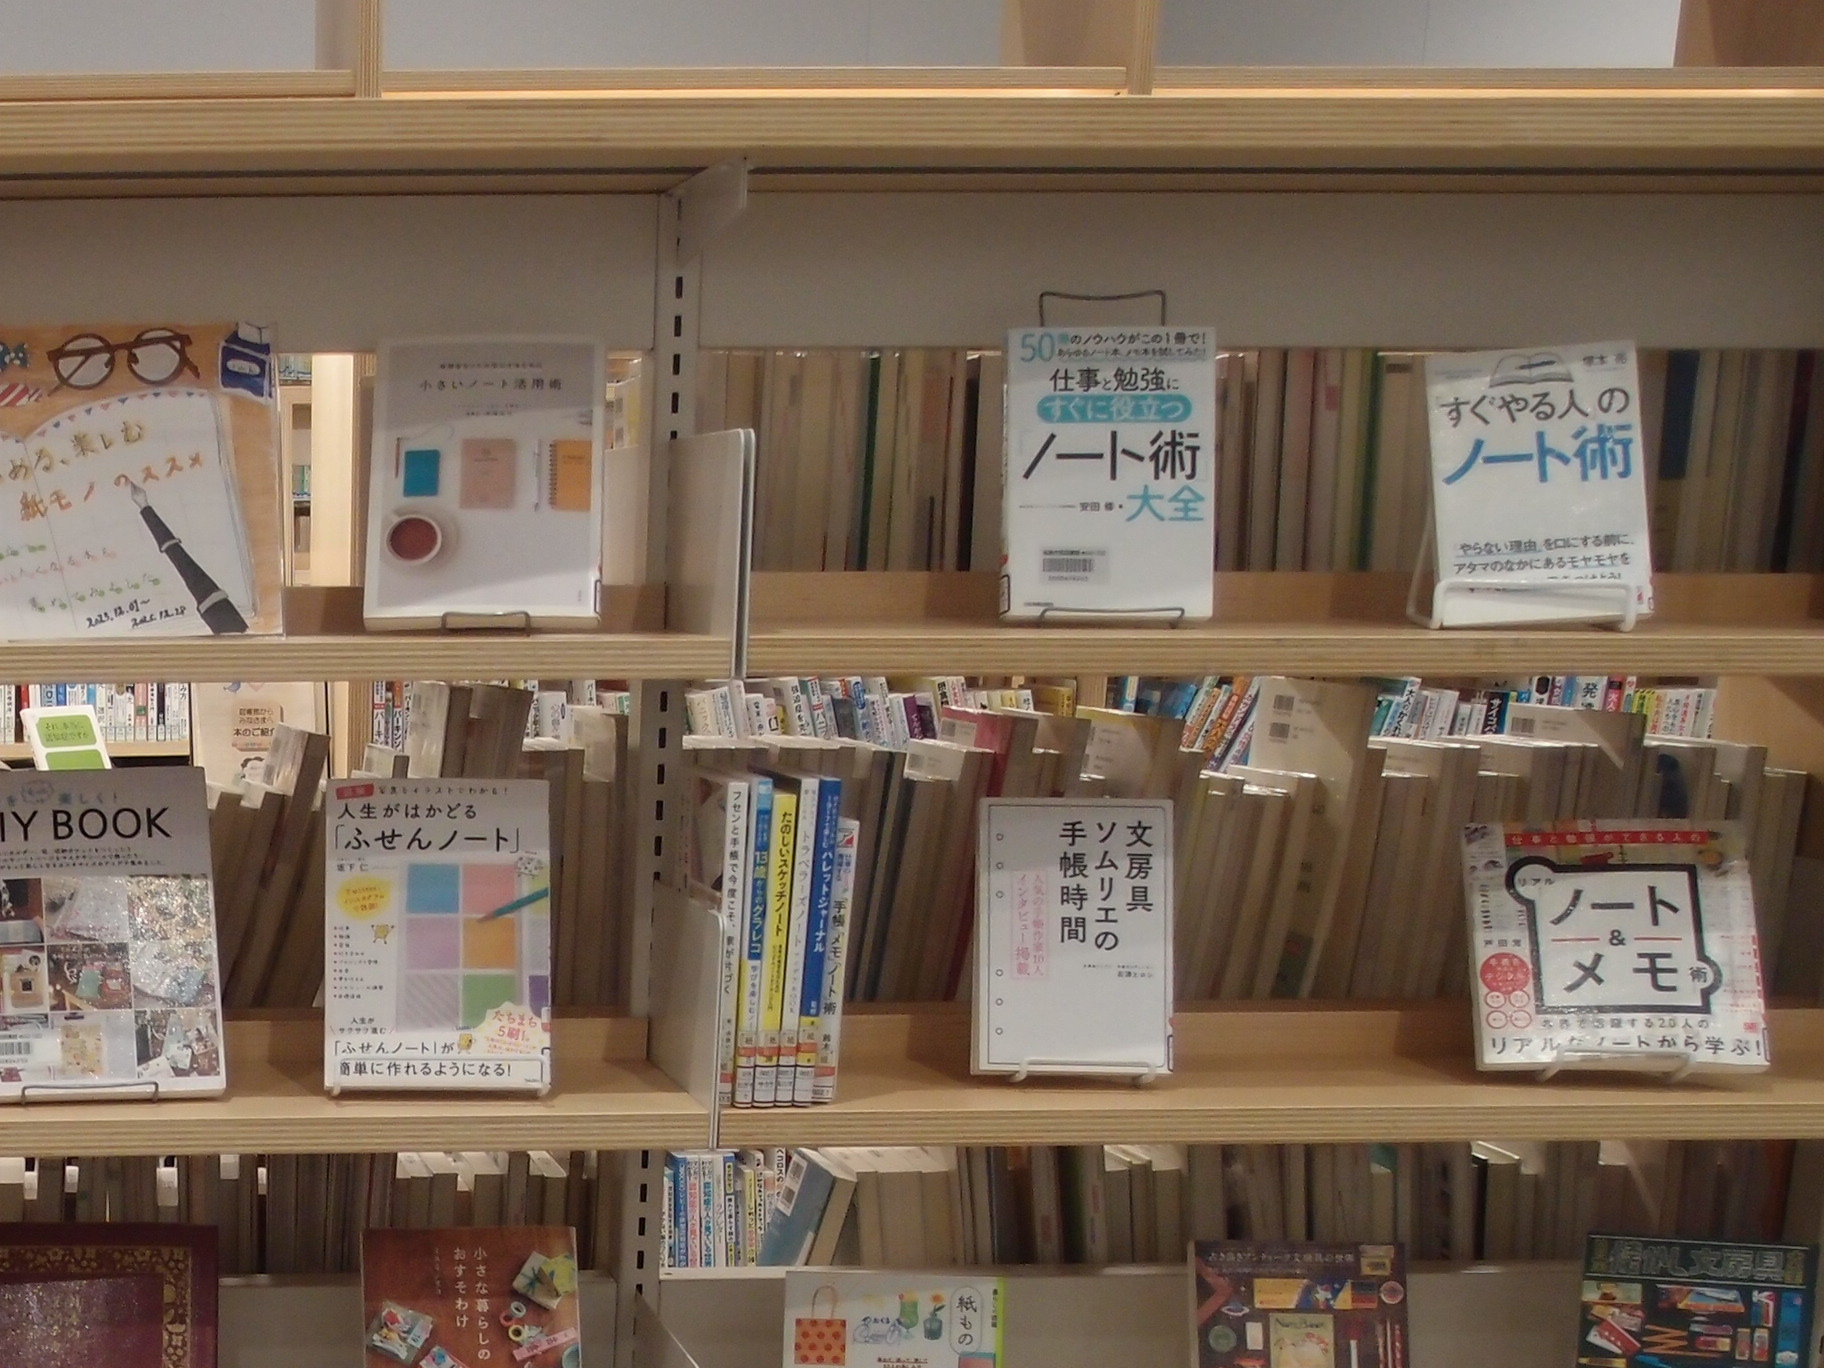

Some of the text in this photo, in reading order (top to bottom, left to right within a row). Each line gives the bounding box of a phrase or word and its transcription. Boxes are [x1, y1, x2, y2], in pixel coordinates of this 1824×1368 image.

[1049, 367, 1180, 392] 仕事と勉強に
[1044, 395, 1185, 421] すぐに役立つ
[1440, 387, 1631, 428] すぐやる人の
[1022, 429, 1201, 481] ノート術
[1441, 423, 1633, 486] ノート術
[1125, 484, 1206, 522] 大全
[1453, 552, 1631, 575] アタマのなかにあるモヤモヤを
[51, 807, 172, 841] BOOK
[337, 803, 478, 820] 人生がはかどる
[334, 823, 520, 854] 「ふせんノート」
[775, 811, 794, 937] たのしいスケッチノート
[1059, 820, 1089, 945] 手帳時間
[1124, 820, 1154, 913] 文房具
[1517, 876, 1556, 887] リアル
[1094, 820, 1120, 952] ソムリエの
[1549, 885, 1681, 926] ノート
[1608, 929, 1627, 947] &
[1563, 952, 1679, 993] メモ
[1688, 966, 1709, 983] 術
[334, 1041, 455, 1056] 「ふせんノート」が
[1490, 1034, 1762, 1058] リアルなノートから学ぶ!
[339, 1061, 512, 1077] 簡単に作れるようになる!
[453, 1246, 470, 1328] おすそわけ
[473, 1246, 491, 1361] 小さな暮らしの
[955, 1294, 978, 1347] 紙もの
